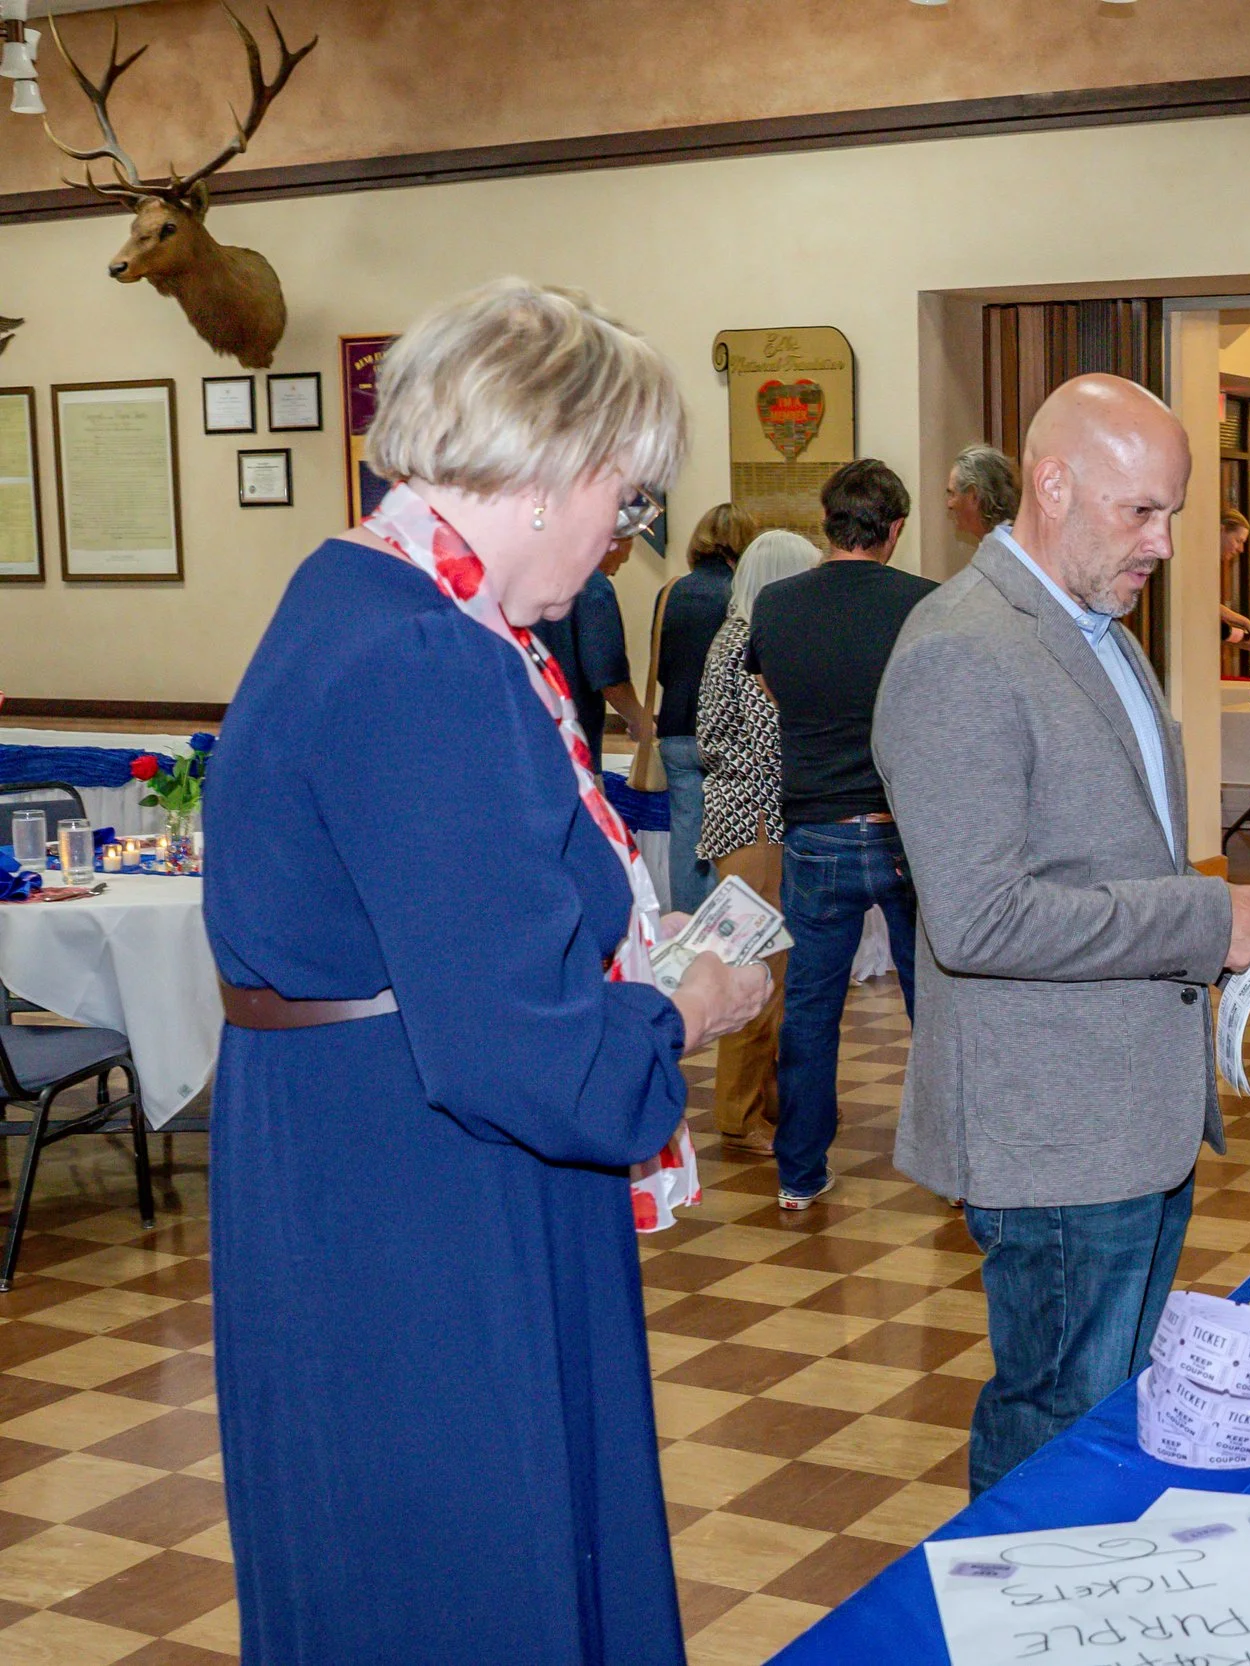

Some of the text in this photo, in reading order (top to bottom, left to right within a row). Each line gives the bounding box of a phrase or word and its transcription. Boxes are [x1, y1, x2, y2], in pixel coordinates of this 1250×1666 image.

[1192, 1326, 1228, 1349] TICKET
[1190, 1353, 1213, 1367] KEEP
[1180, 1362, 1215, 1381] COUPON
[1176, 1383, 1208, 1411] TICKET
[1226, 1433, 1250, 1443] KEEP
[1209, 1455, 1248, 1463] COUPON
[1001, 1569, 1218, 1607] TICKETS
